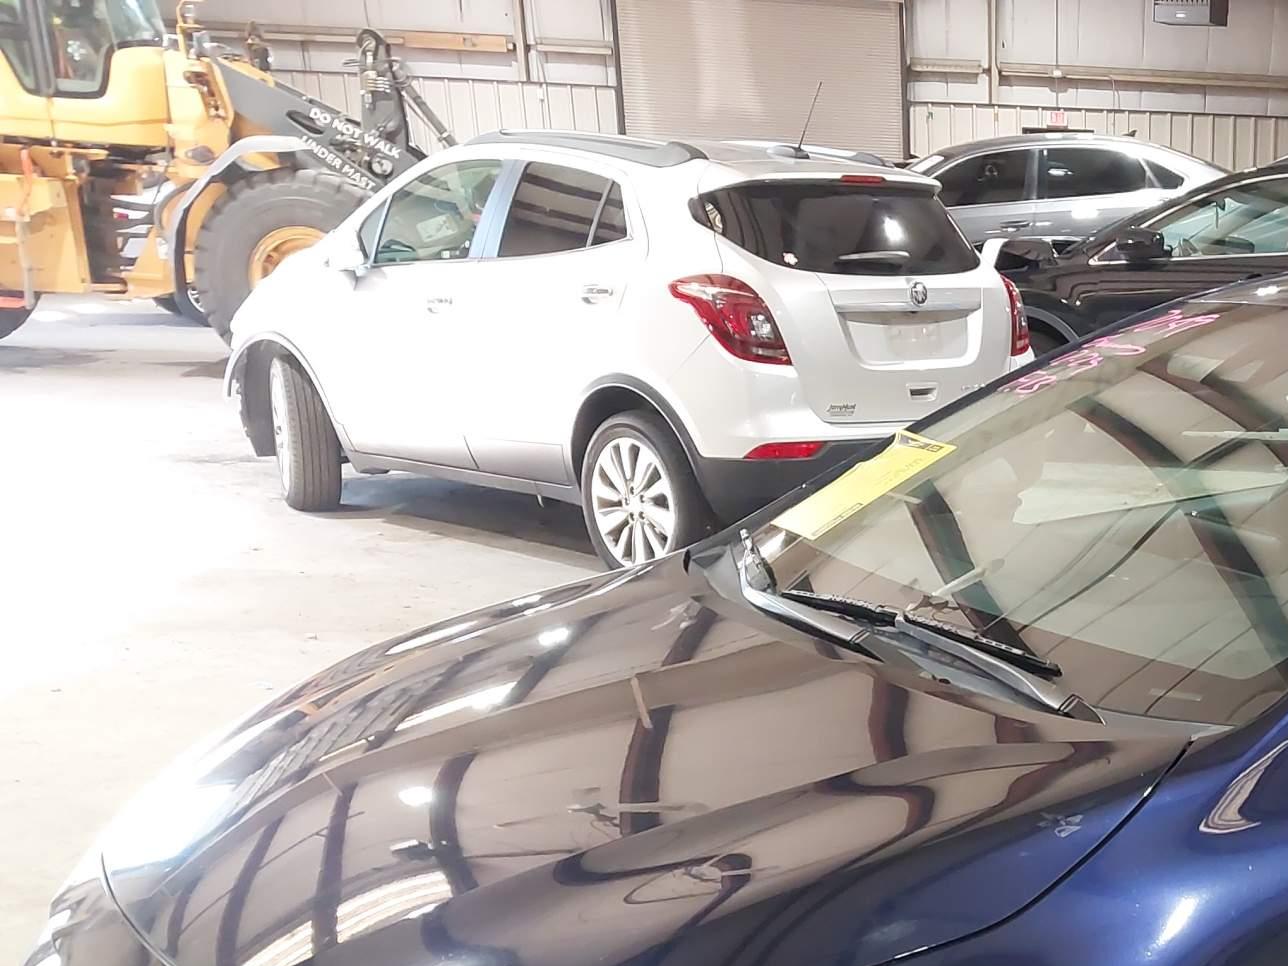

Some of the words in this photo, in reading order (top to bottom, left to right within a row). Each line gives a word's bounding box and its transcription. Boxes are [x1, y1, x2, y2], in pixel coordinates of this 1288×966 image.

[309, 107, 332, 125] DO
[332, 118, 363, 139] NOT
[363, 133, 401, 159] WALK
[302, 135, 343, 169] UNDER
[341, 164, 376, 190] MAST
